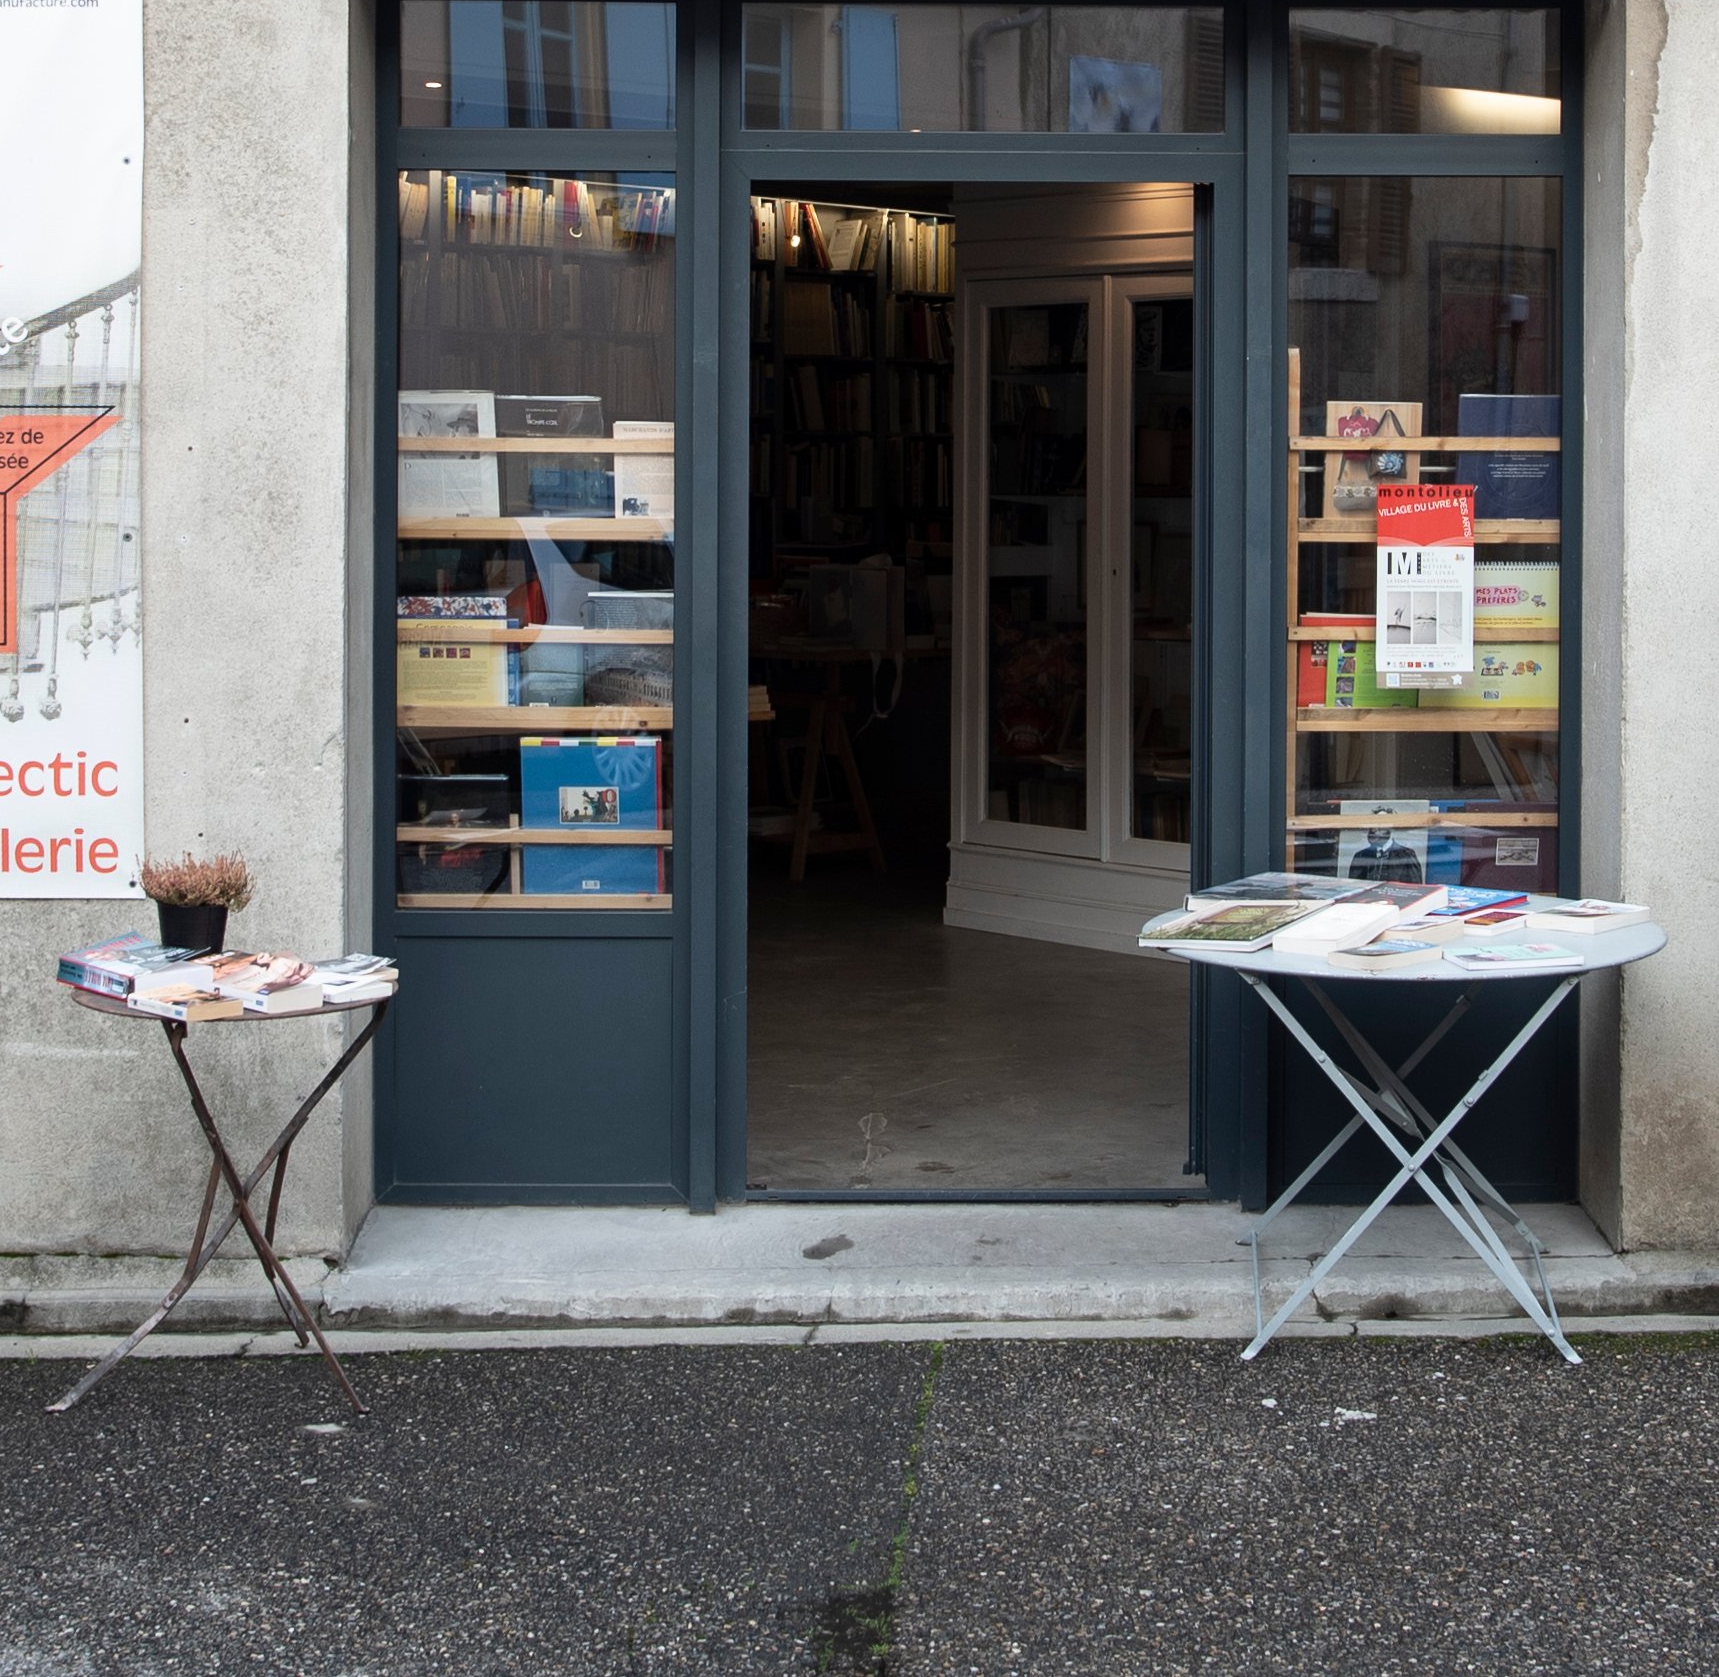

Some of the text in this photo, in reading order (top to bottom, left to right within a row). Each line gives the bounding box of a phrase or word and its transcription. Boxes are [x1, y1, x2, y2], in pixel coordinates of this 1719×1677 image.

[21, 429, 45, 444] de
[1378, 486, 1474, 498] montolieu
[1378, 498, 1459, 517] VILLAGE DU LIVRE &
[1459, 497, 1472, 538] DES ARTS
[1494, 587, 1518, 595] PLATS
